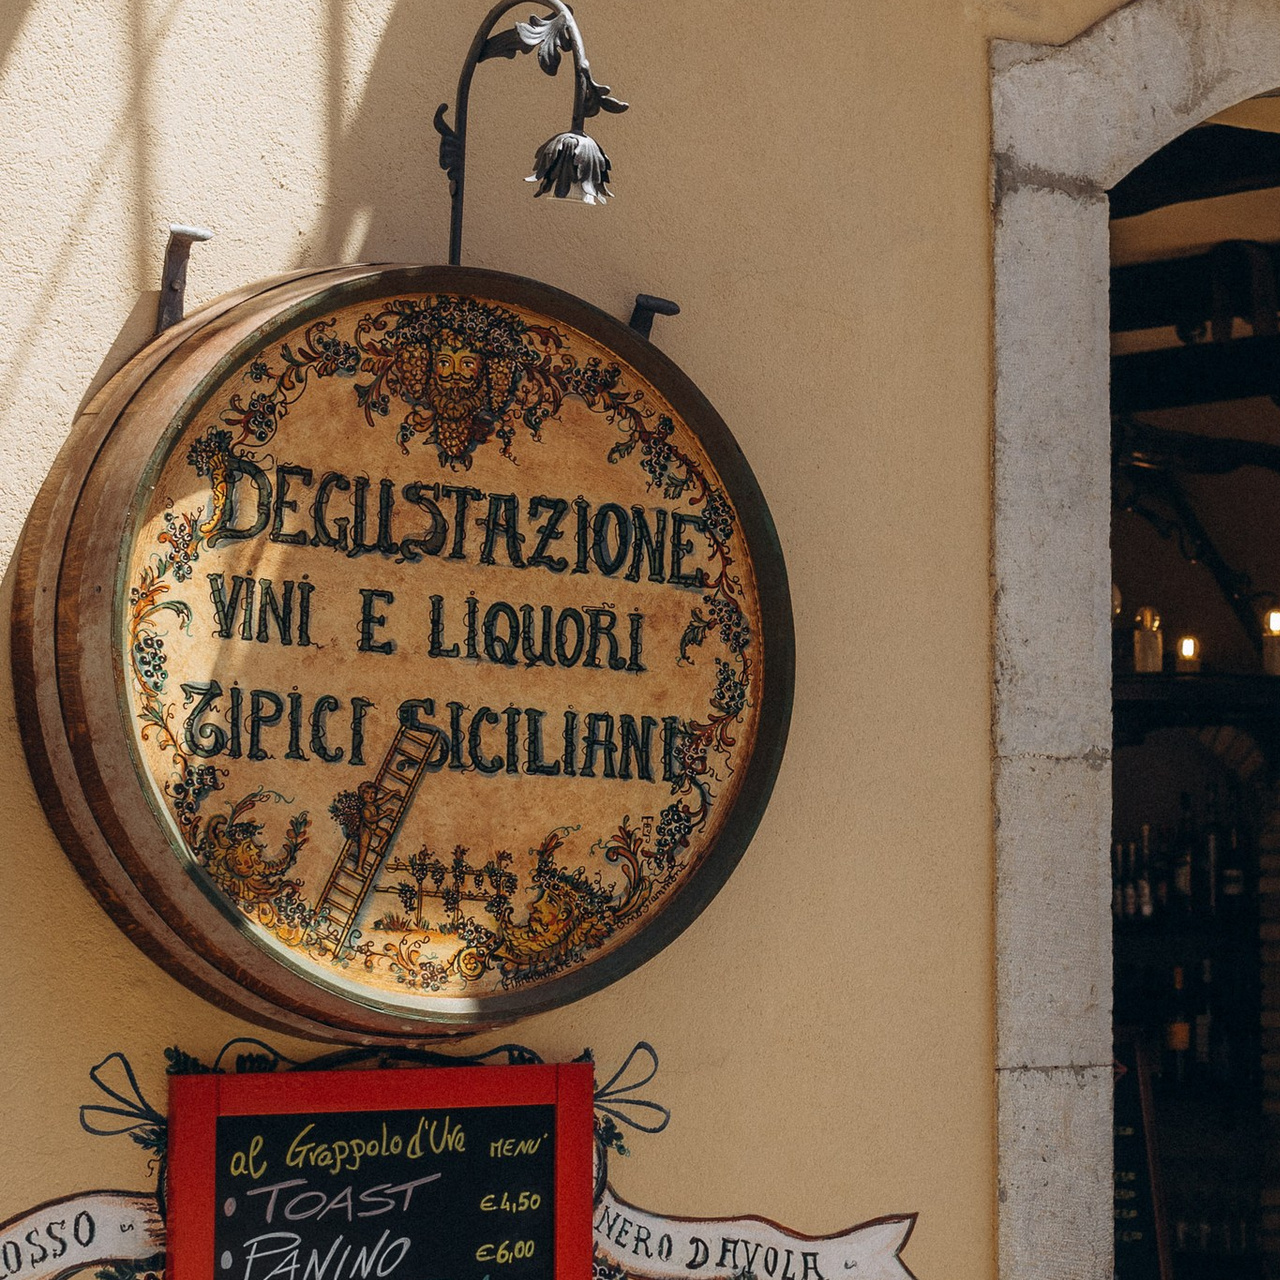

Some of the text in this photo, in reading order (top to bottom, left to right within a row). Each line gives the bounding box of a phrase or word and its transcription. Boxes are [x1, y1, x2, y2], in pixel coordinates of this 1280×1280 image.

[205, 456, 710, 590] DEGUSTAZIONE
[206, 572, 648, 673] VINI E LIQUORI
[181, 680, 690, 785] TIPICI SICILIANI
[230, 1134, 267, 1179] al
[286, 1122, 402, 1175] Grappolo
[246, 1173, 541, 1224] TOAST €4,50
[0, 1210, 95, 1280] OSSO
[475, 1240, 536, 1264] €6,00
[594, 1205, 673, 1263] NERO
